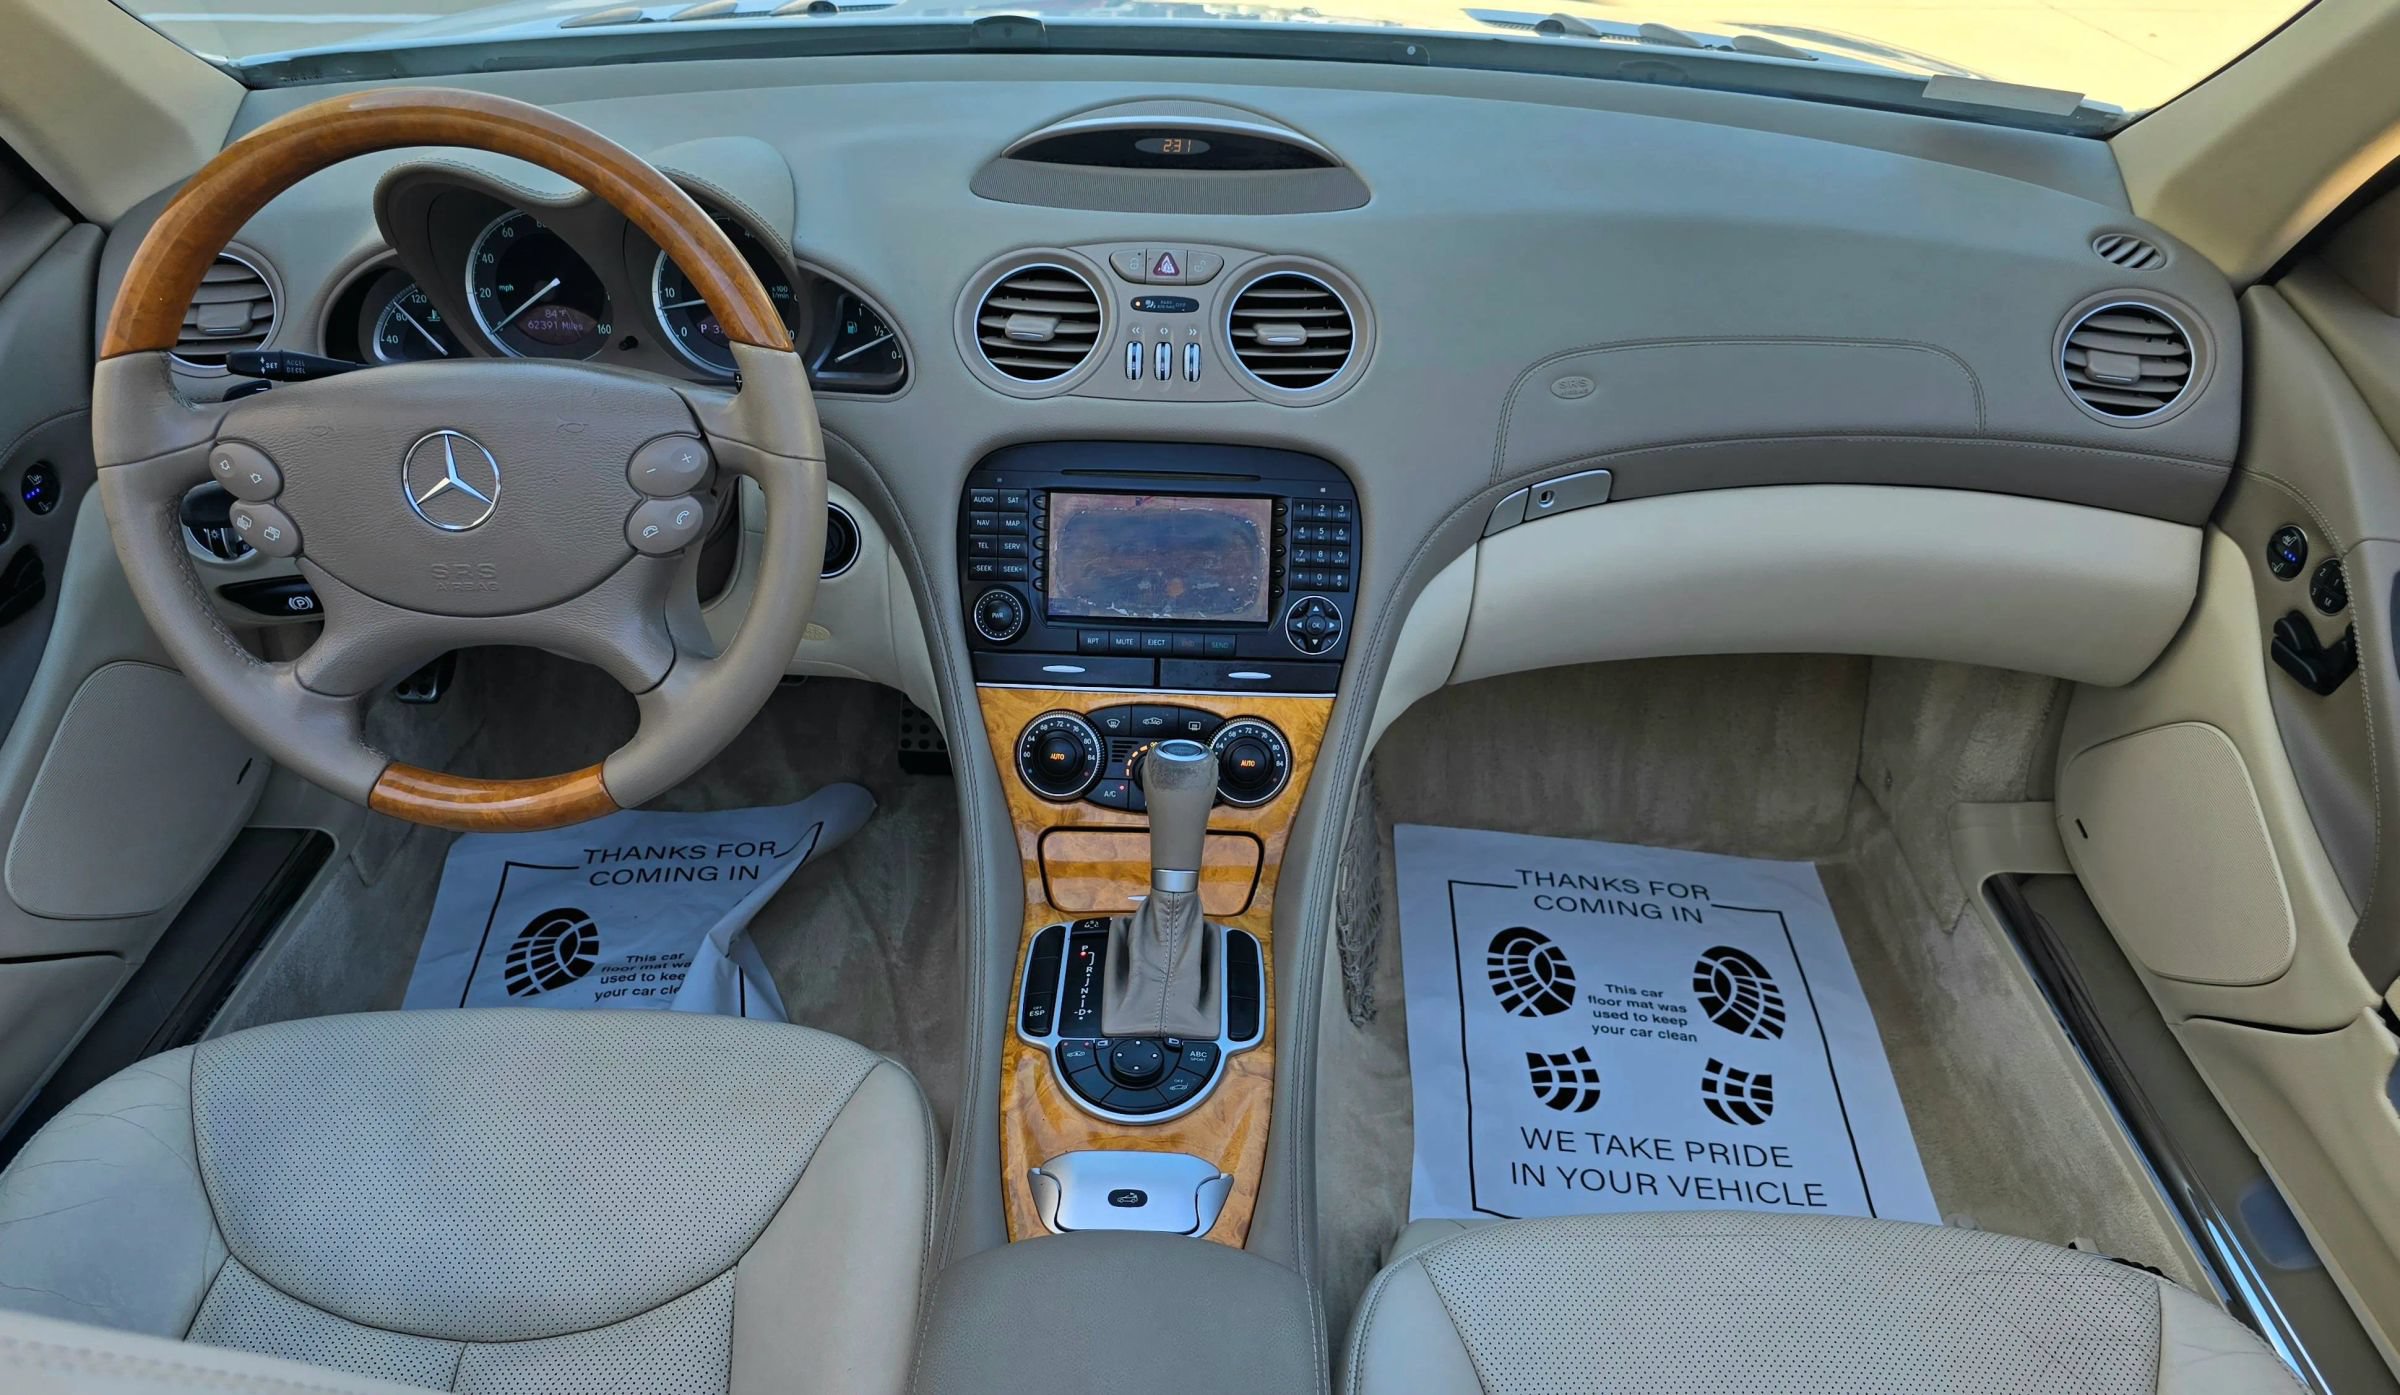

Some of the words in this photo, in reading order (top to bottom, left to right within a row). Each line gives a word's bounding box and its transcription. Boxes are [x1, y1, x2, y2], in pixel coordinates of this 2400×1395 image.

[502, 227, 514, 237] 60
[482, 253, 495, 264] 40
[480, 288, 492, 298] 20
[498, 284, 514, 292] mph
[664, 287, 676, 298] 10
[411, 294, 428, 304] 120
[527, 319, 559, 330] 62391
[562, 320, 584, 332] Miles
[597, 324, 612, 335] 160
[701, 323, 708, 334] P
[681, 327, 688, 337] 0
[386, 335, 398, 344] 40
[891, 350, 897, 359] 0
[1559, 379, 1588, 390] SRS
[1319, 504, 1325, 512] 2
[1339, 505, 1345, 513] 3
[976, 519, 990, 527] NAV
[1299, 527, 1305, 535] 4
[1298, 550, 1304, 558] 7
[1337, 551, 1343, 559] 9
[431, 563, 497, 578] SRS
[1317, 573, 1323, 581] 0
[1087, 637, 1099, 645] RPT
[1115, 638, 1134, 646] MUTE
[1104, 790, 1116, 798] A/C
[584, 846, 707, 865] THANKS
[716, 841, 776, 858] FOR
[589, 866, 718, 886] COMING
[729, 865, 759, 881] IN
[1515, 869, 1640, 894] THANKS
[1649, 881, 1710, 901] FOR
[1534, 895, 1663, 920] COMING
[1672, 906, 1703, 924] IN
[626, 955, 657, 964] This
[661, 953, 685, 961] car
[601, 965, 637, 973] floor
[600, 973, 637, 985] used
[641, 973, 655, 982] to
[660, 972, 686, 981] kee
[594, 988, 628, 1003] your
[632, 988, 656, 996] car
[1604, 984, 1637, 995] This
[1641, 989, 1664, 998] car
[1588, 995, 1622, 1007] floor
[1626, 1000, 1654, 1010] mat
[1657, 1003, 1687, 1013] was
[1593, 1010, 1629, 1020] used
[1633, 1012, 1648, 1022] to
[1652, 1014, 1688, 1028] keep
[1592, 1024, 1625, 1036] your
[1630, 1028, 1653, 1038] car
[1658, 1029, 1698, 1043] clean
[1190, 1050, 1207, 1058] ABC
[1520, 1126, 1577, 1152] WE
[1585, 1132, 1674, 1161] TAKE
[1685, 1141, 1793, 1168] PRIDE
[1511, 1162, 1545, 1187] IN
[1557, 1166, 1658, 1196] YOUR
[1667, 1175, 1828, 1207] VEHICLE
